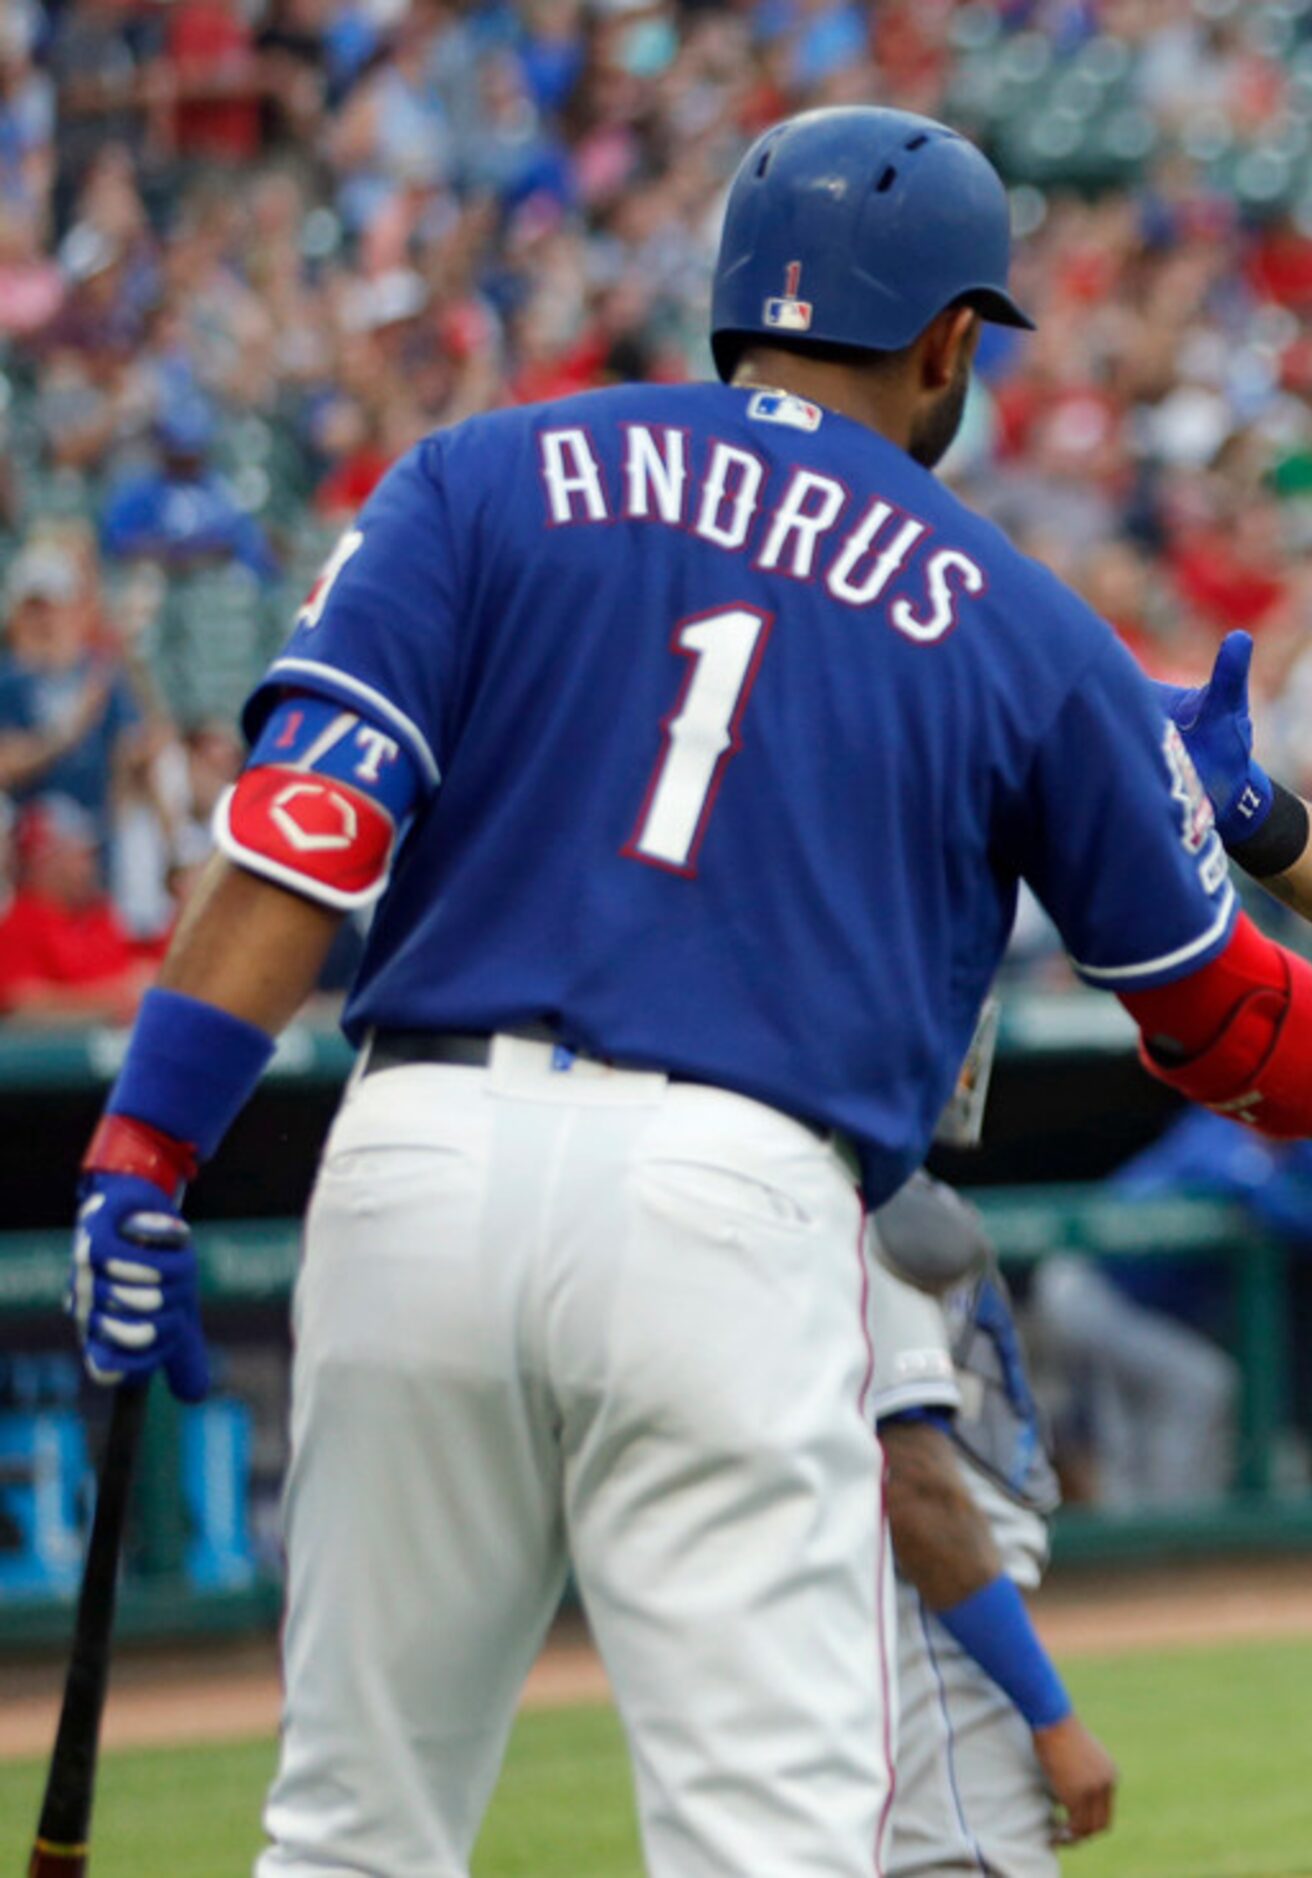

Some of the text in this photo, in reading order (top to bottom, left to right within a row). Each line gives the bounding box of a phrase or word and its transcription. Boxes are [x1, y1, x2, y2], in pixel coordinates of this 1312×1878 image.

[785, 261, 801, 299] 1
[539, 422, 986, 646] ANDRUS
[275, 711, 399, 784] 1 T
[619, 600, 775, 880] 1
[1237, 785, 1261, 819] 17
